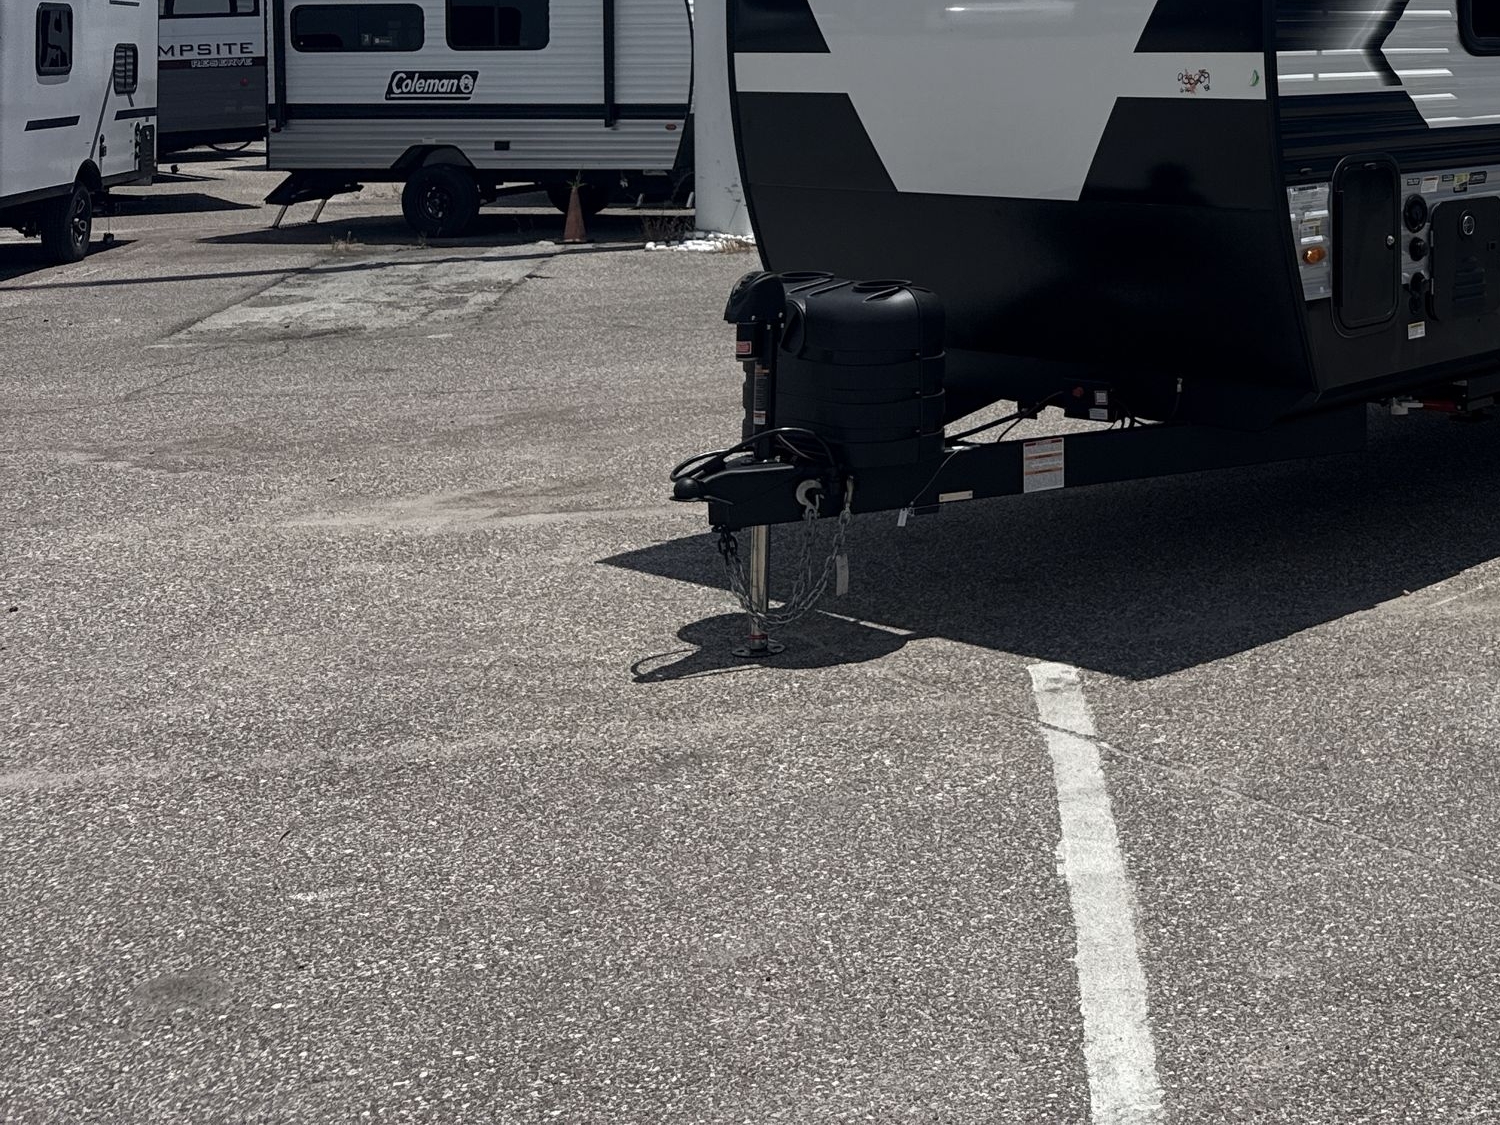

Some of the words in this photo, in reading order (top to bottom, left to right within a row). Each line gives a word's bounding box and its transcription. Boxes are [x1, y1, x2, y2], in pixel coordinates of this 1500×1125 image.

[158, 42, 254, 57] MPSITE
[191, 57, 254, 68] RESERVE
[392, 72, 458, 93] Coleman
